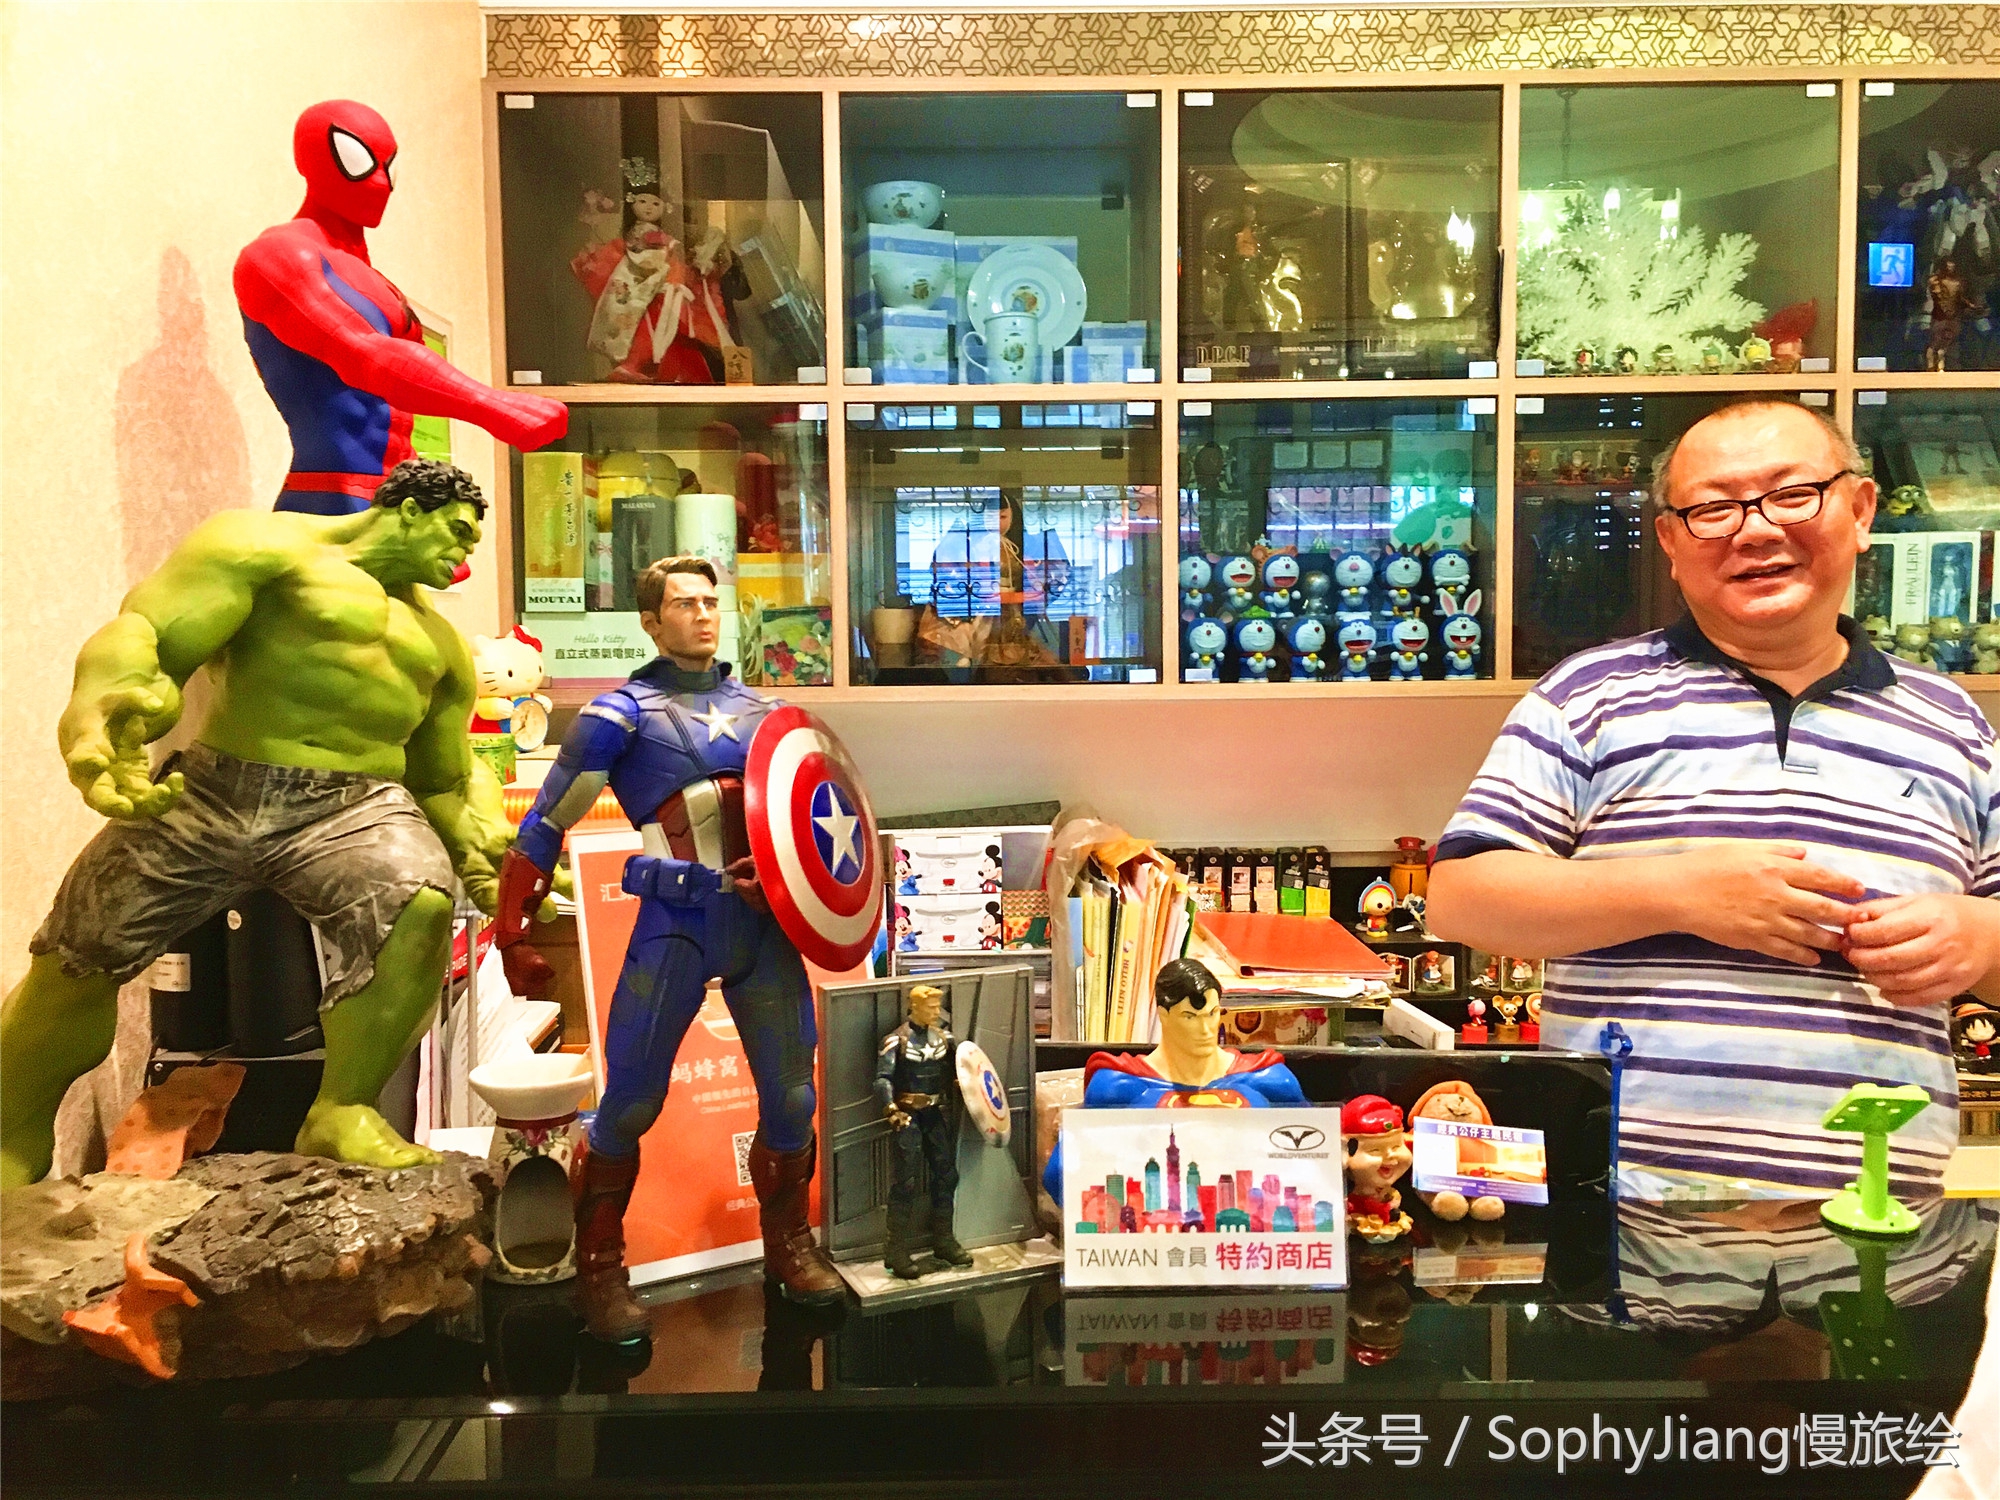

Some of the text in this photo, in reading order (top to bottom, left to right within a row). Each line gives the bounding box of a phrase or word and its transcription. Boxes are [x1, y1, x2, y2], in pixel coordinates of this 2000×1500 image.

[528, 596, 582, 604] MOUTAI
[574, 633, 628, 647] Hello Kitty
[1117, 960, 1129, 1014] HELLO KITTY
[1076, 1242, 1333, 1270] TAIWAN 會員 特約商店
